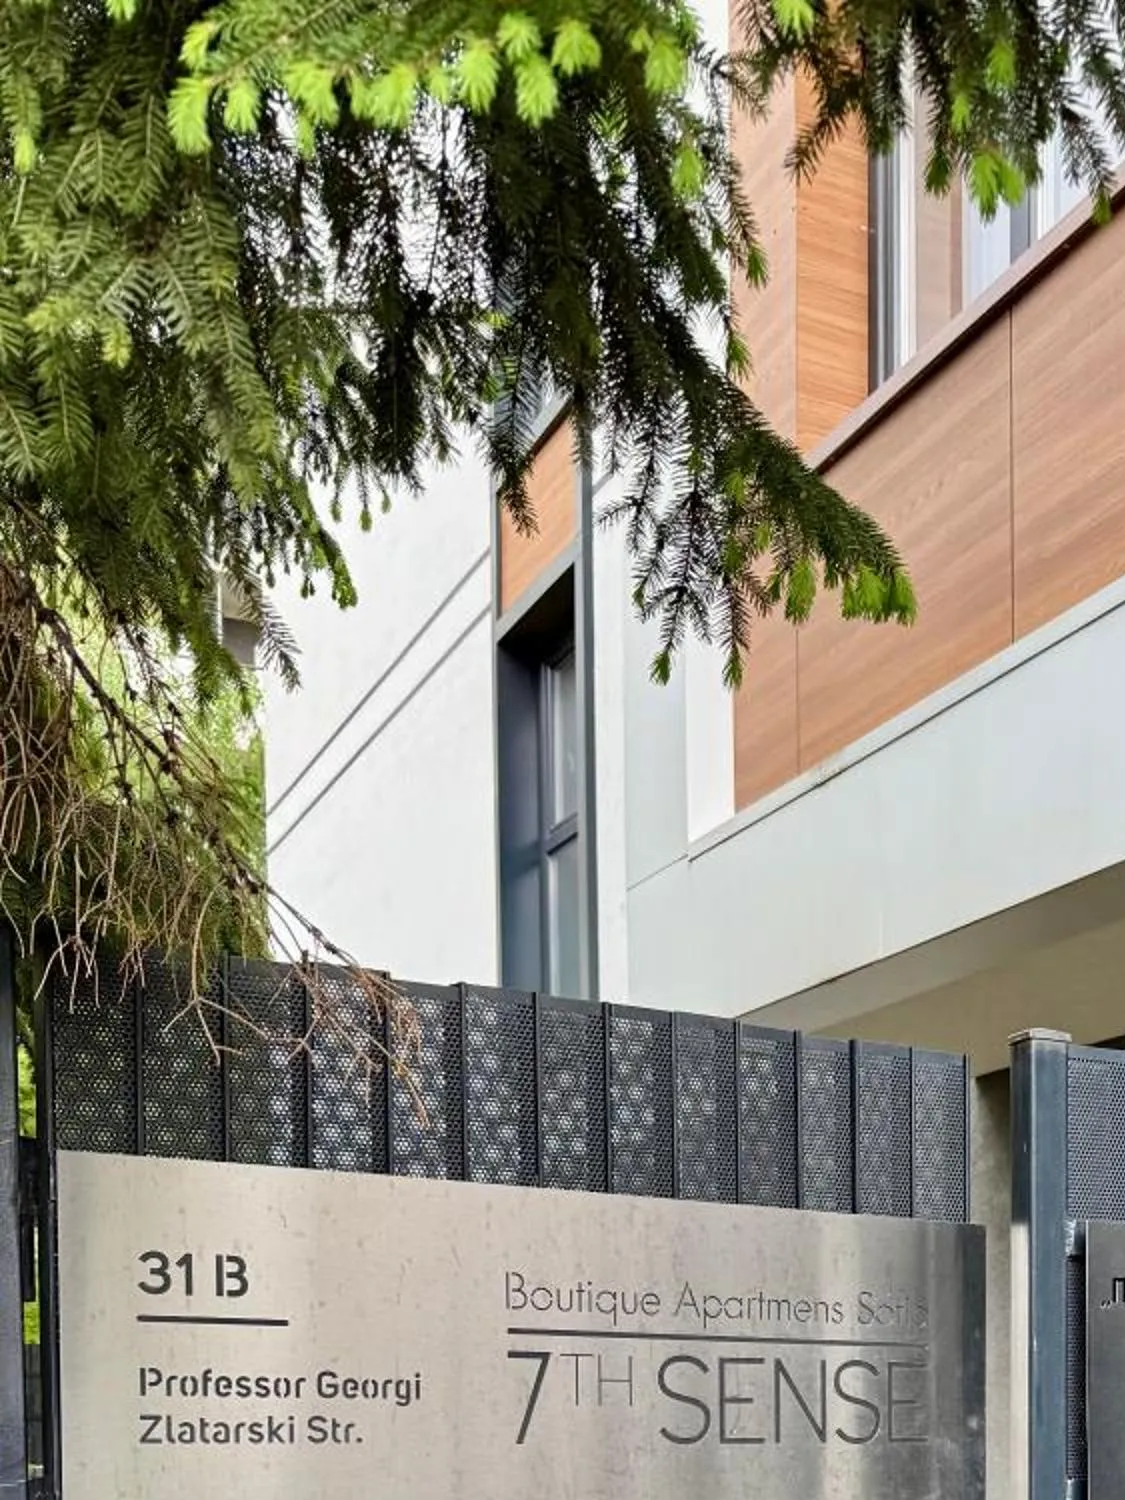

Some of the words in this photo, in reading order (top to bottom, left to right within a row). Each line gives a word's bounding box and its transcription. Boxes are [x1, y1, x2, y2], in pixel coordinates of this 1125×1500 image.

[137, 1250, 194, 1296] 31
[215, 1254, 249, 1297] B
[505, 1271, 661, 1326] Boutique
[674, 1281, 844, 1329] Apartmens
[139, 1367, 307, 1400] Professor
[316, 1370, 422, 1407] Georgi
[657, 1355, 929, 1445] SENSE
[139, 1415, 295, 1445] Zlatarski
[306, 1415, 364, 1445] Str.
